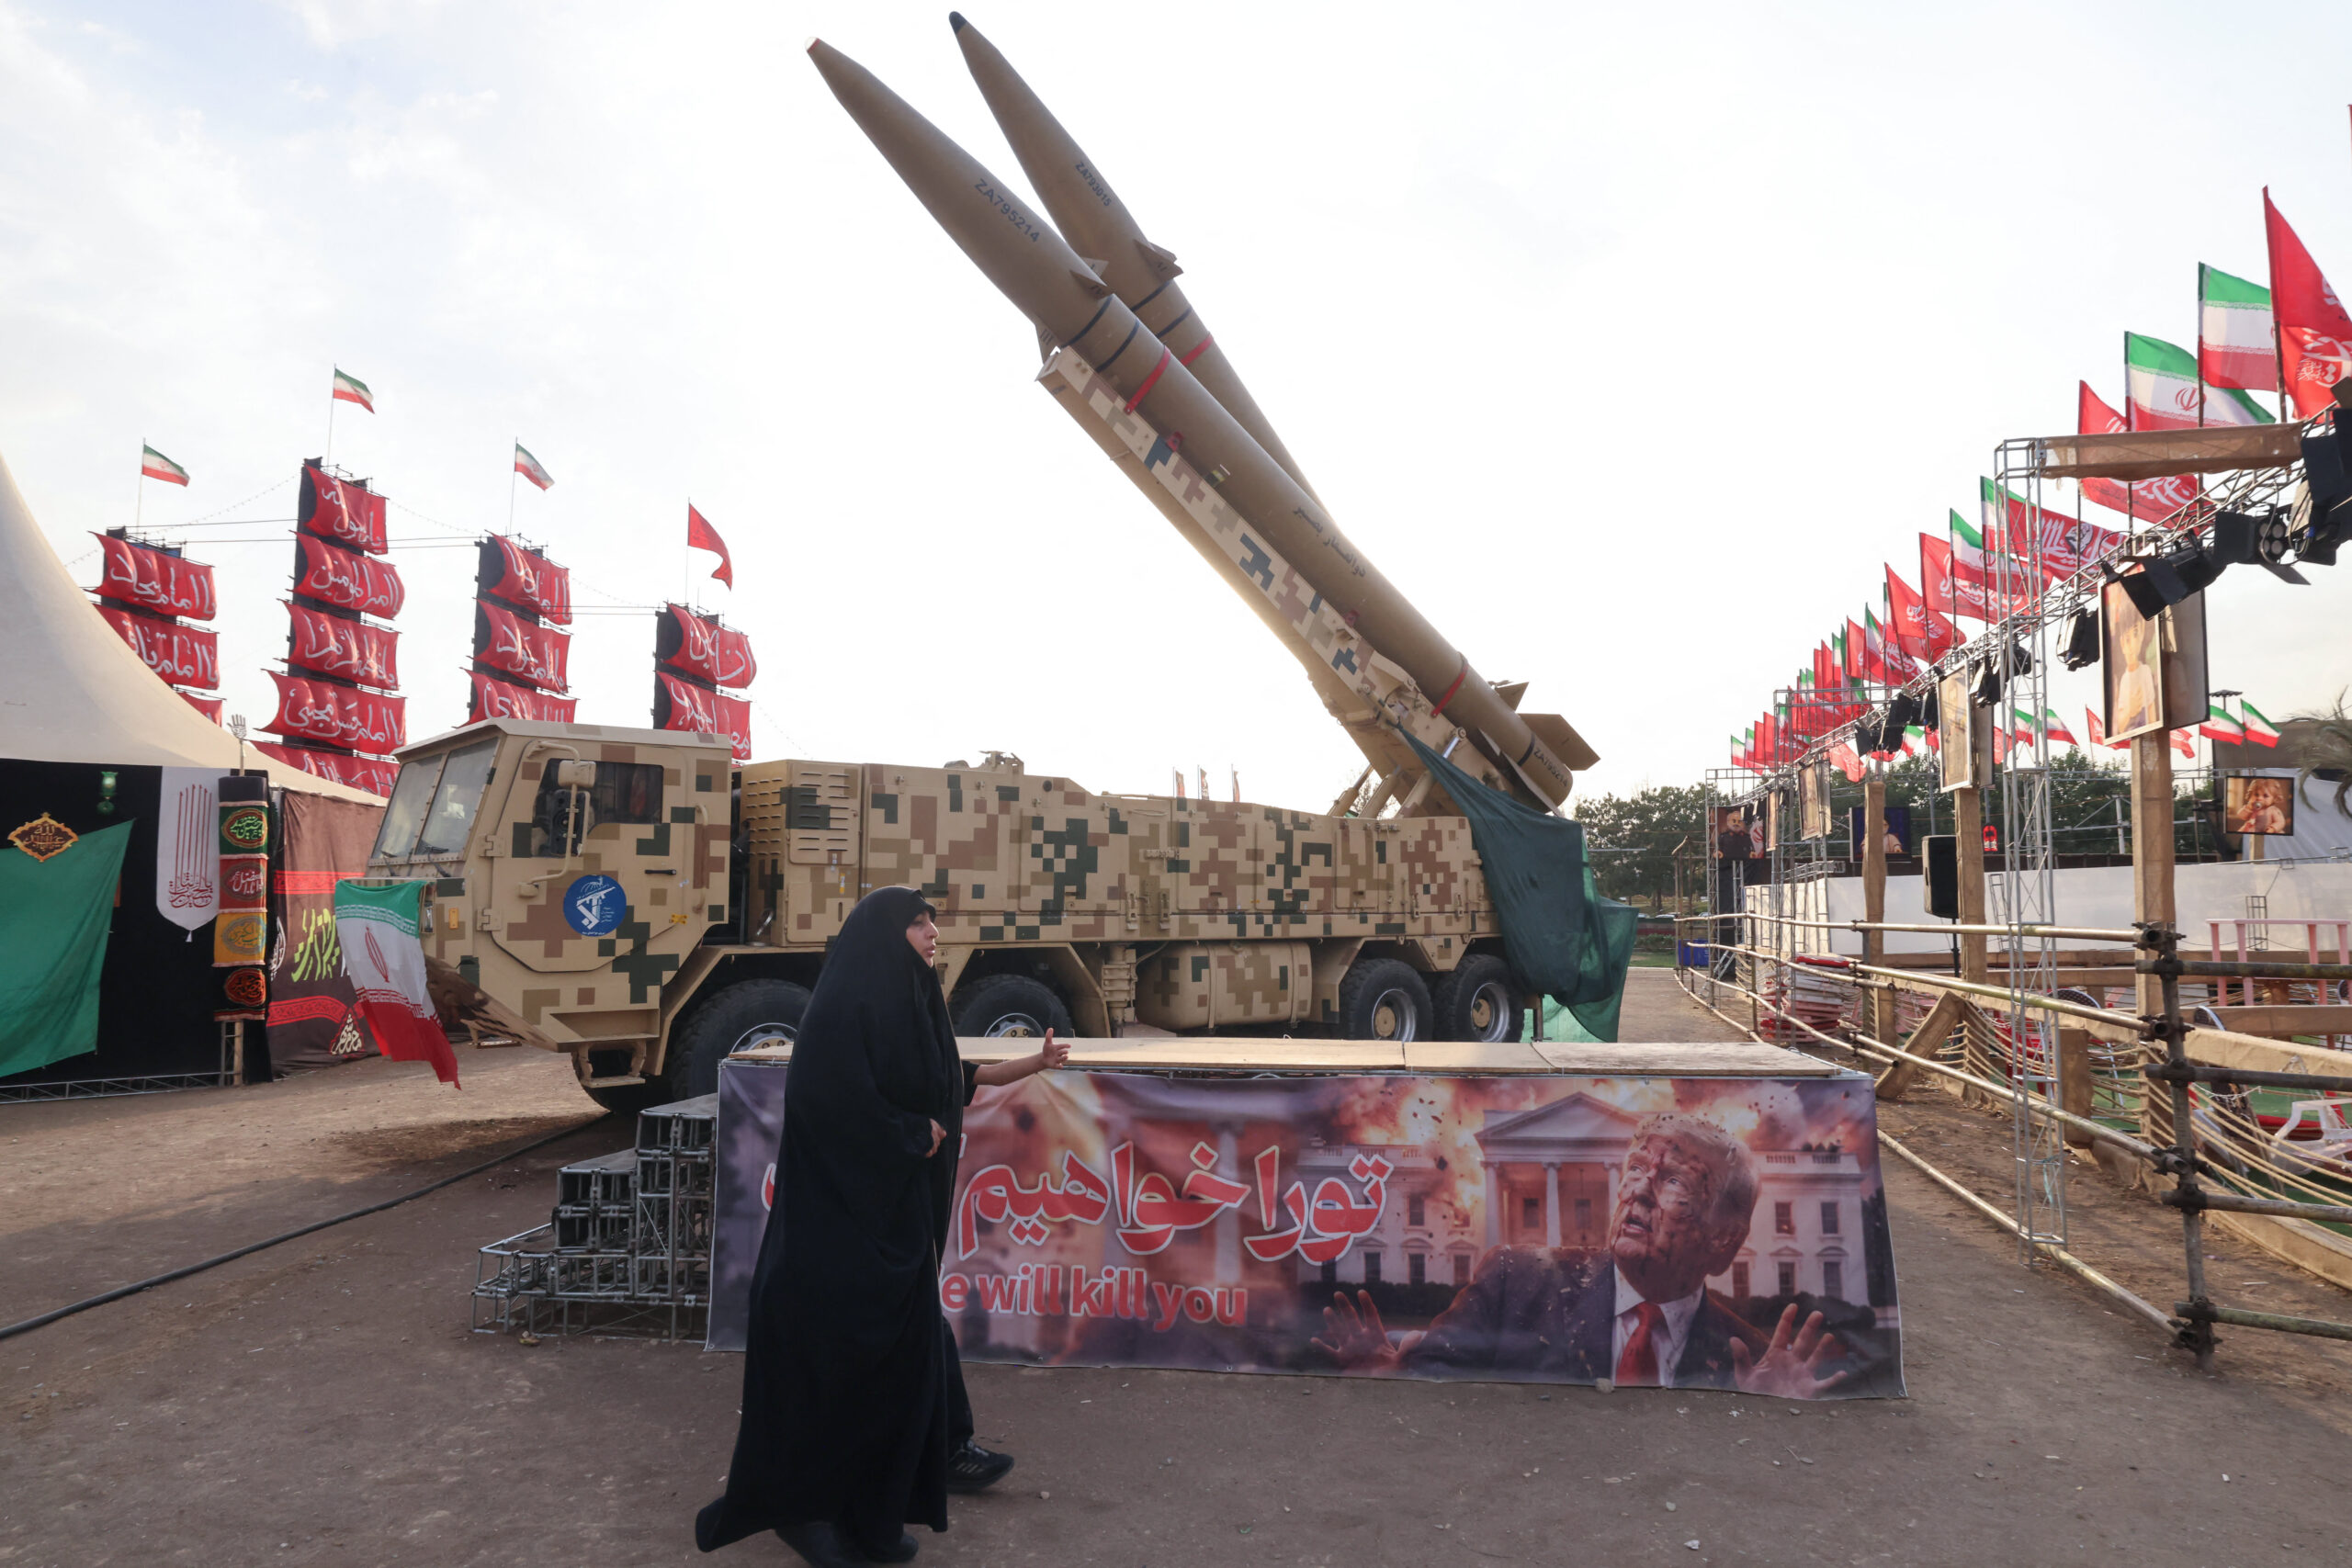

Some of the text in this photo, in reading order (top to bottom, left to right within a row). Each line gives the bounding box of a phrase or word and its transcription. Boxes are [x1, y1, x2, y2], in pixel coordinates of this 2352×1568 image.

[975, 178, 1040, 243] ZA795214
[1076, 162, 1112, 206] ZA793015
[958, 1141, 1251, 1260] خواهیم
[938, 1262, 1248, 1331] e will kill you
